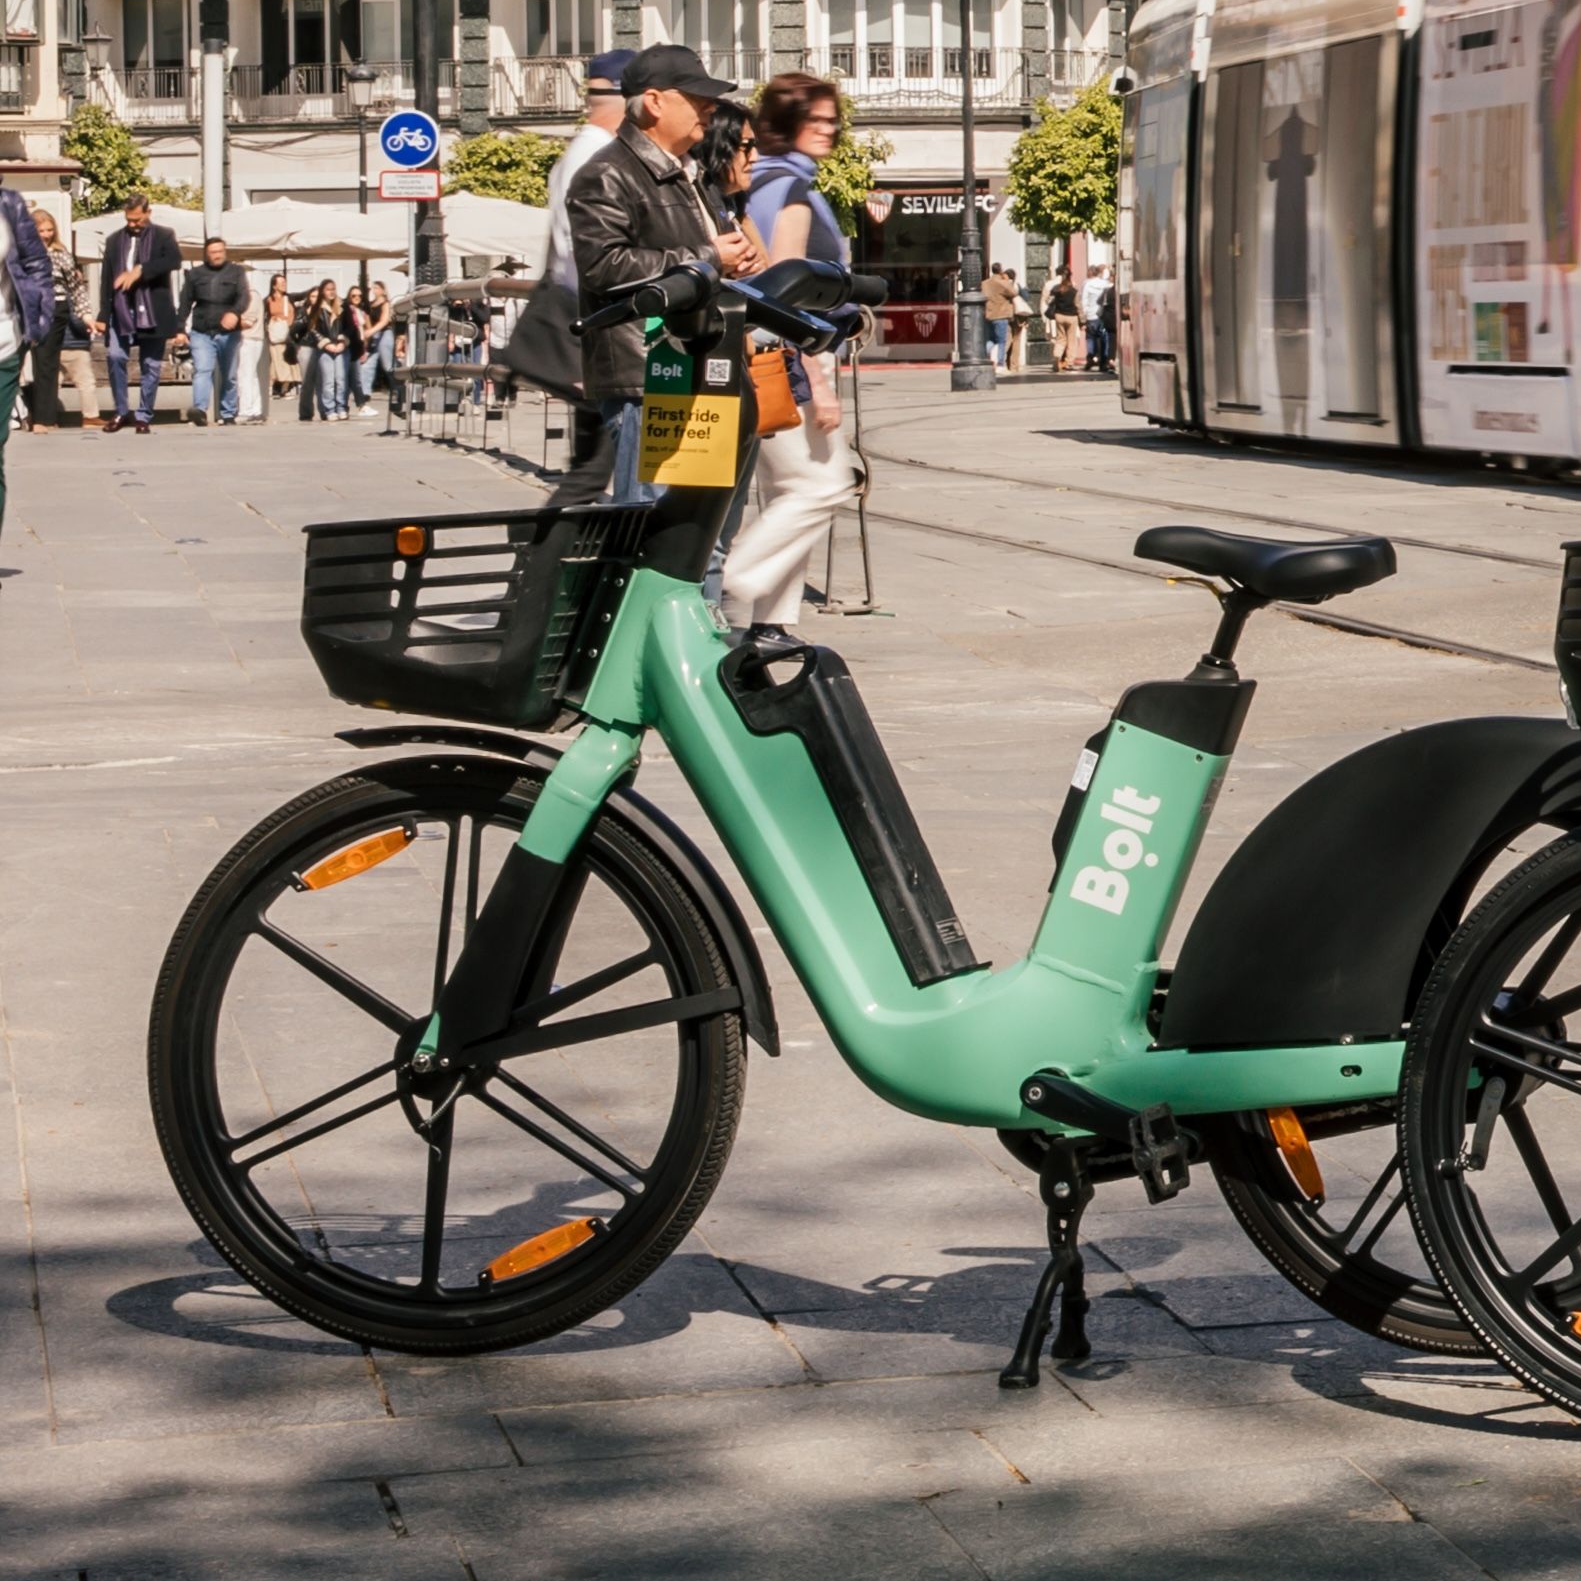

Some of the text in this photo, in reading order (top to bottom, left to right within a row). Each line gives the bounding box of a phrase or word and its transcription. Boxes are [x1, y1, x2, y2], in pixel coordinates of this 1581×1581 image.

[651, 363, 683, 381] Bolt
[648, 406, 720, 423] First ride
[646, 423, 711, 439] for free!
[1069, 785, 1161, 915] Bolt
